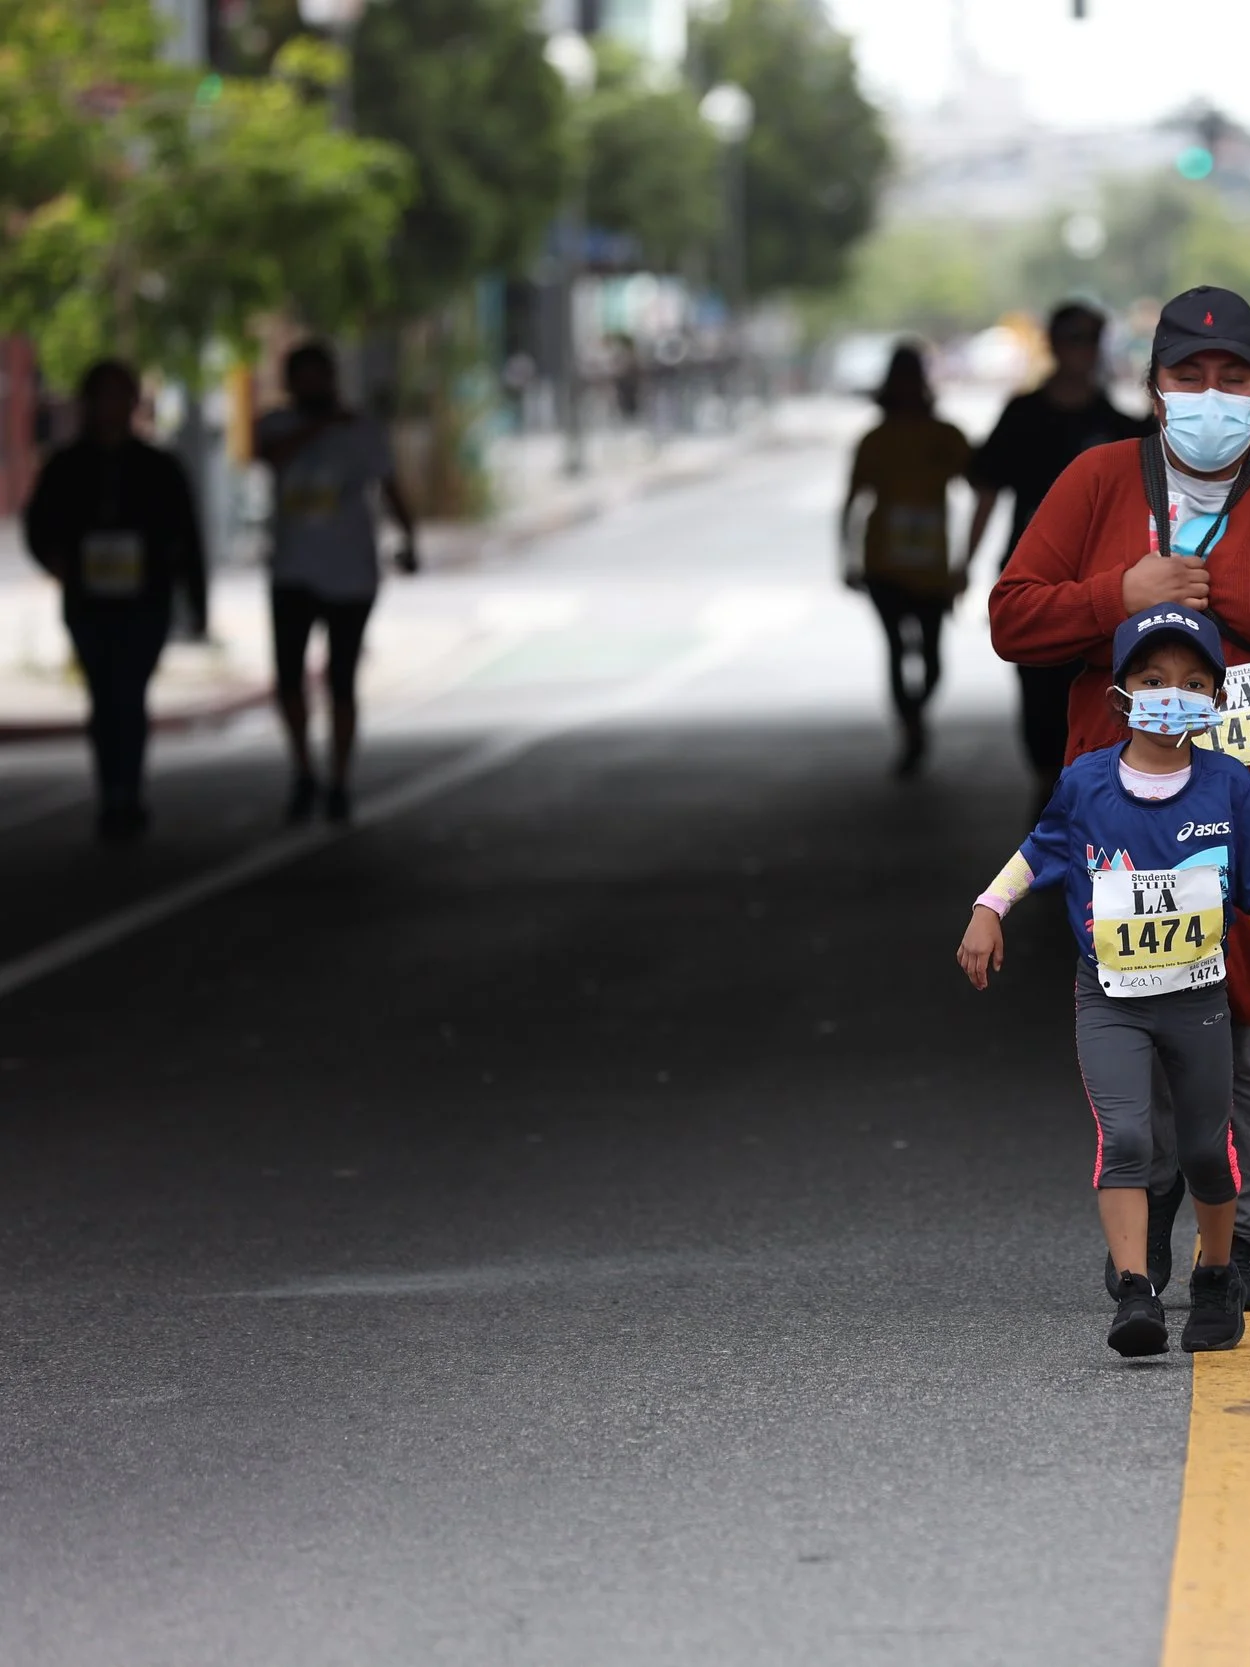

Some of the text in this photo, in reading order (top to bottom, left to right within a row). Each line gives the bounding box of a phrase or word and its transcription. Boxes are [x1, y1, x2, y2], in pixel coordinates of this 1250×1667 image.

[1195, 822, 1229, 836] asics
[1131, 873, 1176, 881] Students
[1132, 889, 1178, 915] LA
[1117, 915, 1205, 956] 1474
[1190, 958, 1216, 970] BAG CHECK
[1120, 974, 1162, 987] Leah
[1190, 965, 1219, 983] 1474
